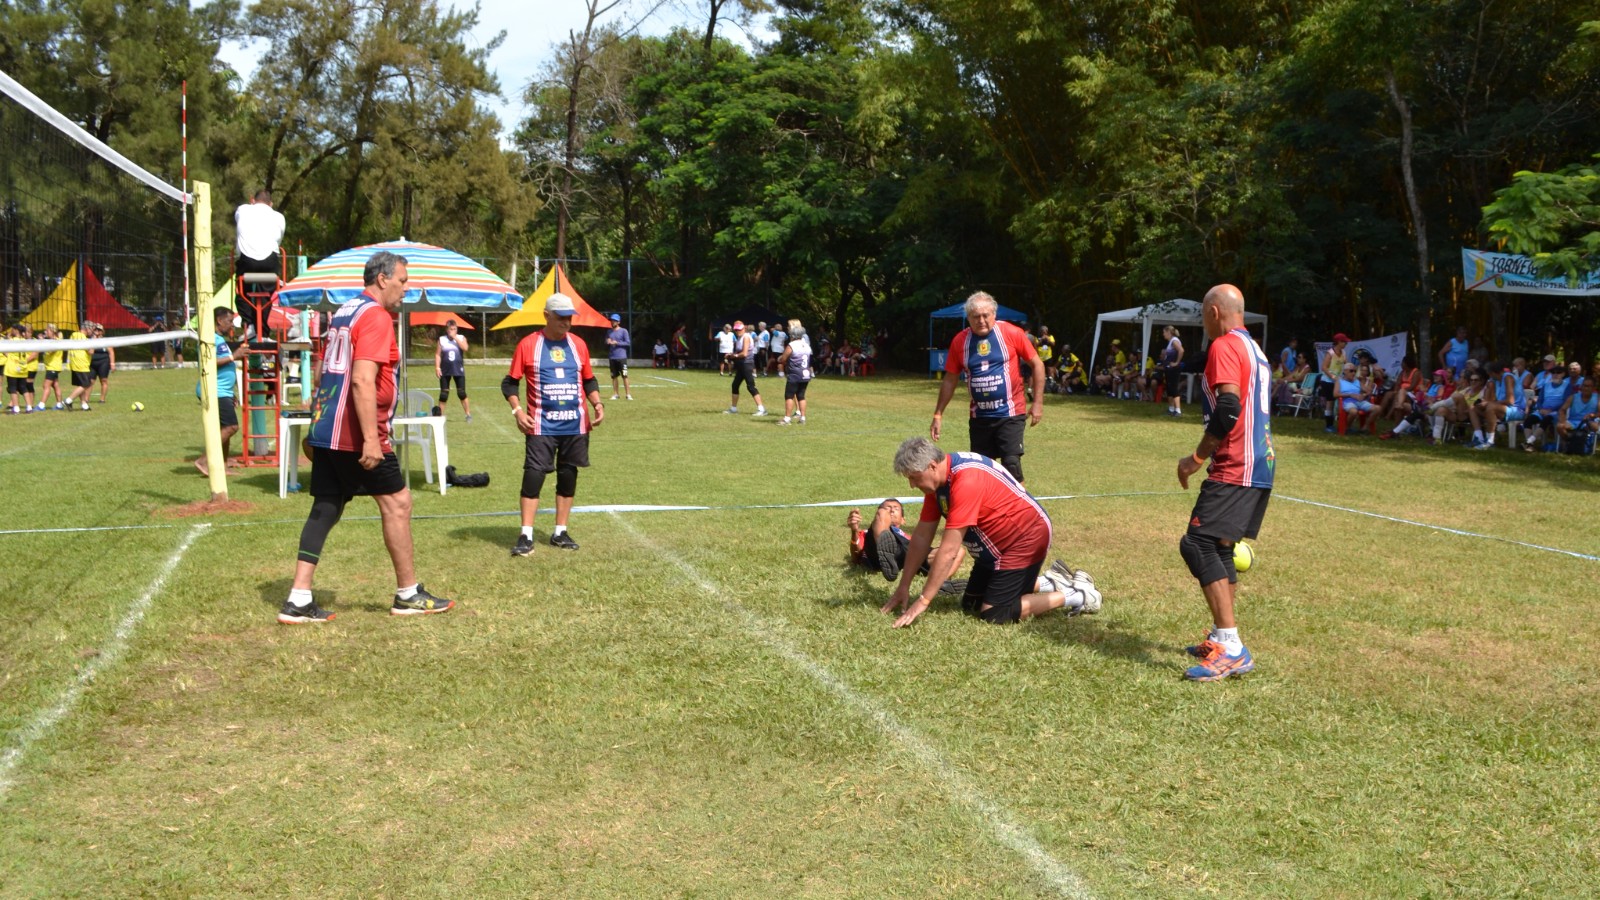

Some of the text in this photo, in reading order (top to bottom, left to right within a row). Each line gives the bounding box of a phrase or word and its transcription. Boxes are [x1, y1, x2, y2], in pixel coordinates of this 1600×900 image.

[449, 351, 456, 362] 9
[802, 355, 808, 369] 3
[546, 411, 579, 420] SEMEL
